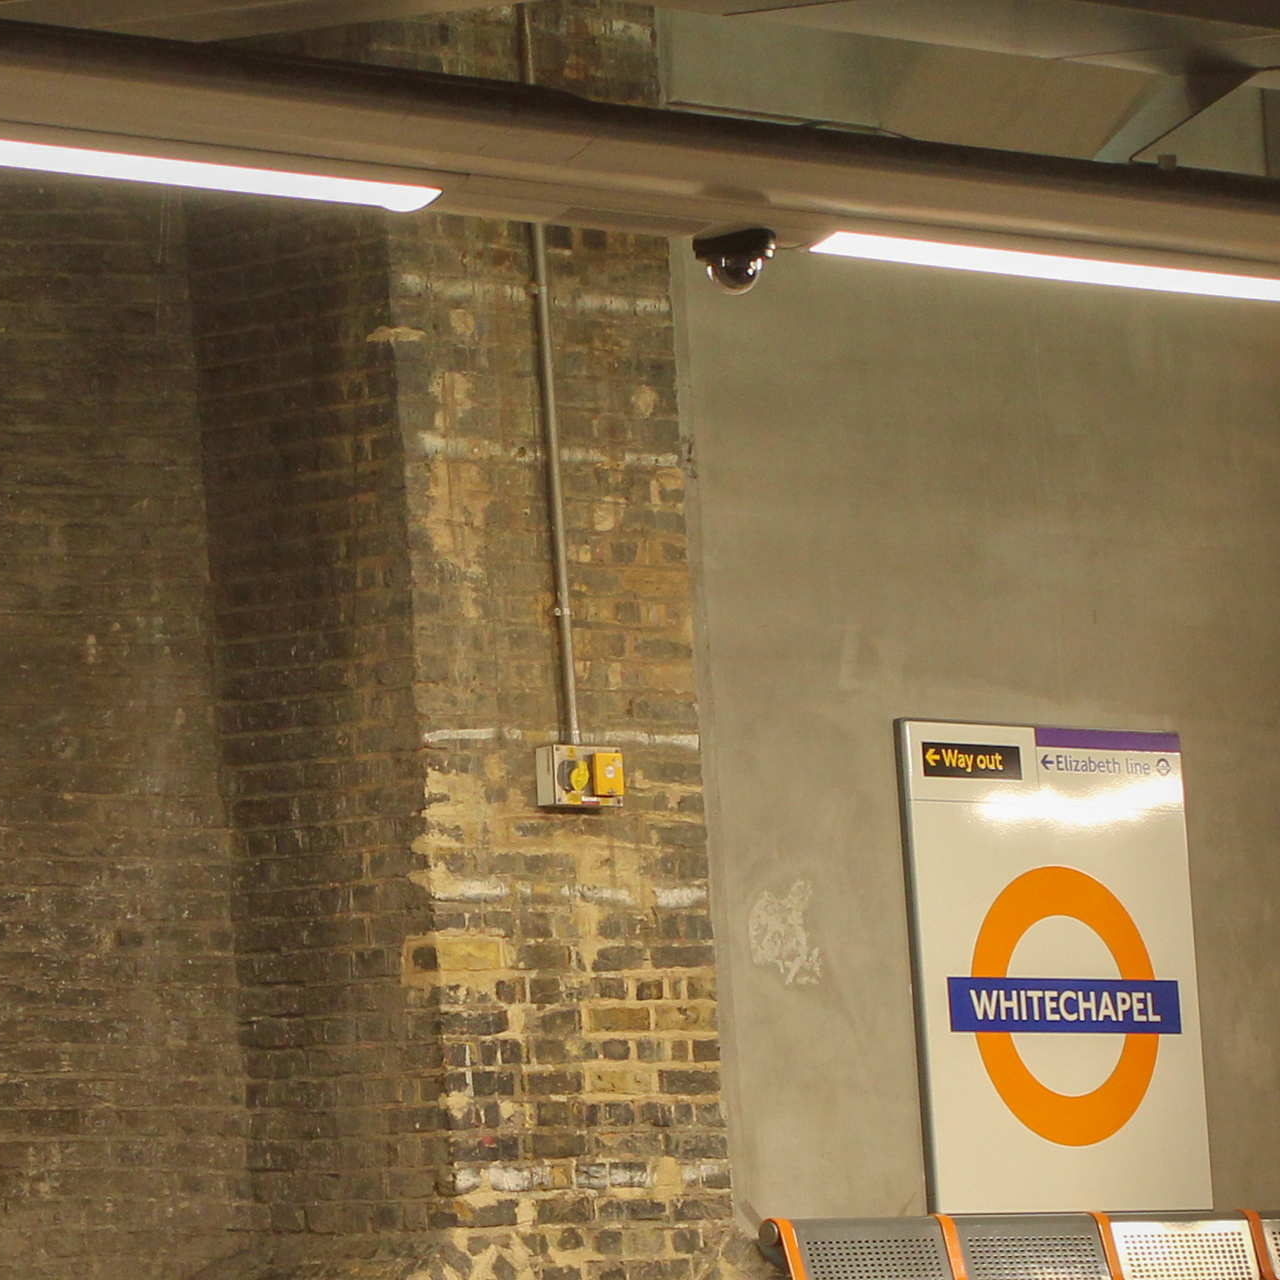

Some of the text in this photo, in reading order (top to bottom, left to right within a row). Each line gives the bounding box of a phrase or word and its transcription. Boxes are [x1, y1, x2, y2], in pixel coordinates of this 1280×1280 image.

[941, 748, 1004, 773] Way out
[1056, 754, 1151, 775] Elizabeth line
[969, 988, 1161, 1022] WHITECHAPEL
